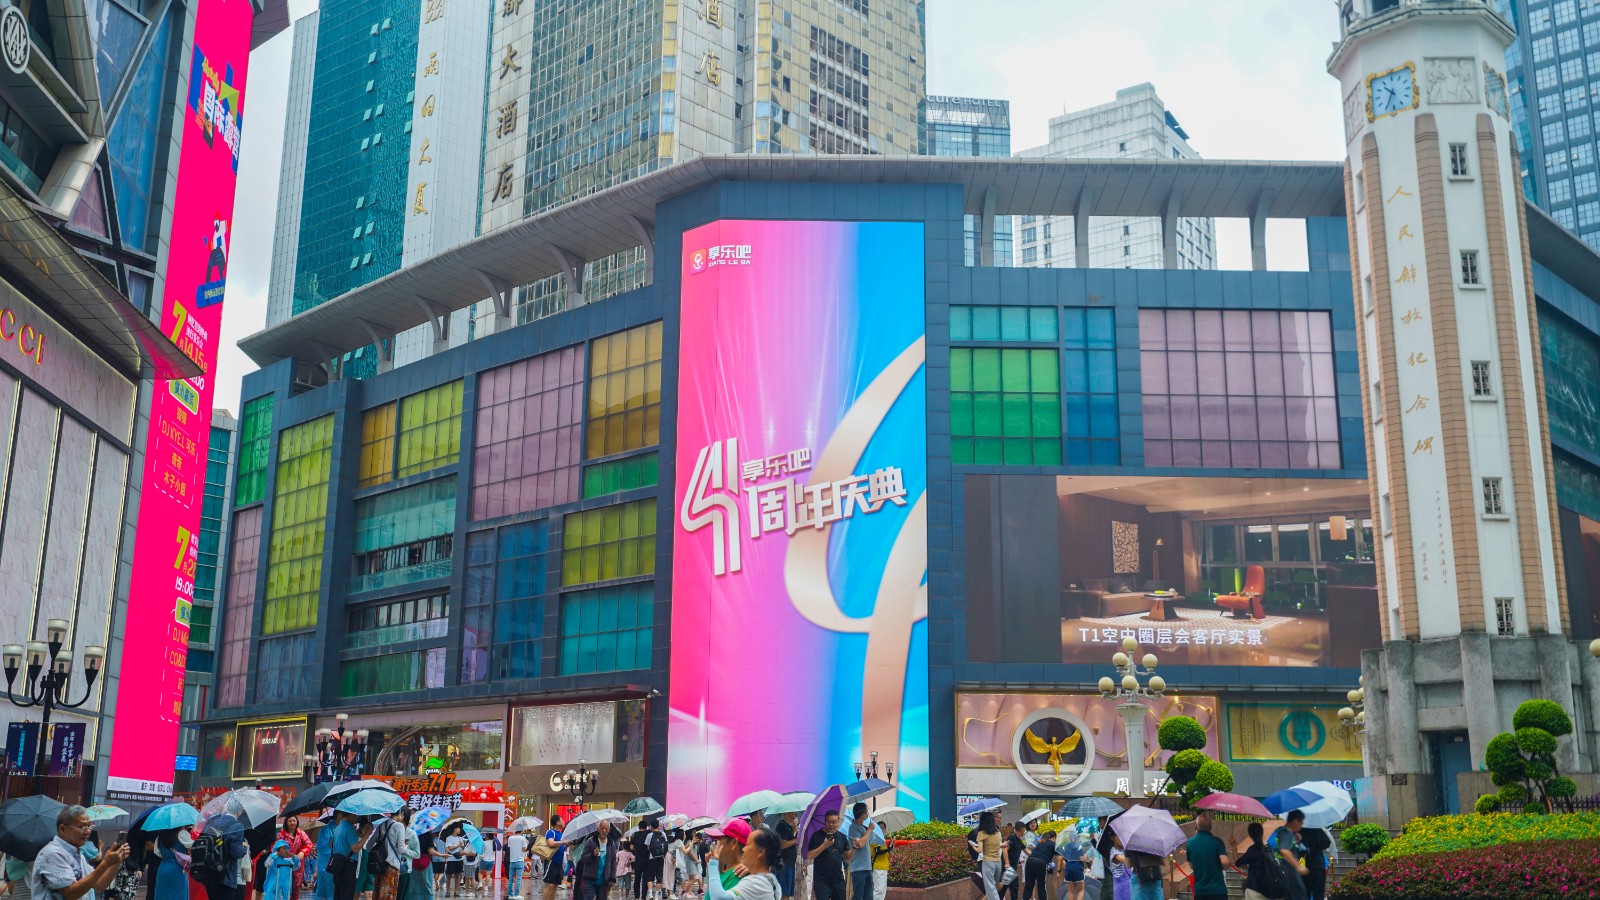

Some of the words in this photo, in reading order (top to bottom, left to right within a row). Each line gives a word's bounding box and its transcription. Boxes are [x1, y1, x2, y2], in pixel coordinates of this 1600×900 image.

[708, 245, 752, 260] 享乐吧
[742, 447, 812, 482] 享乐吧
[743, 466, 908, 540] 周年庆典
[1078, 627, 1263, 646] T1空中圈层会客厅实景
[409, 793, 462, 812] 美好生活节
